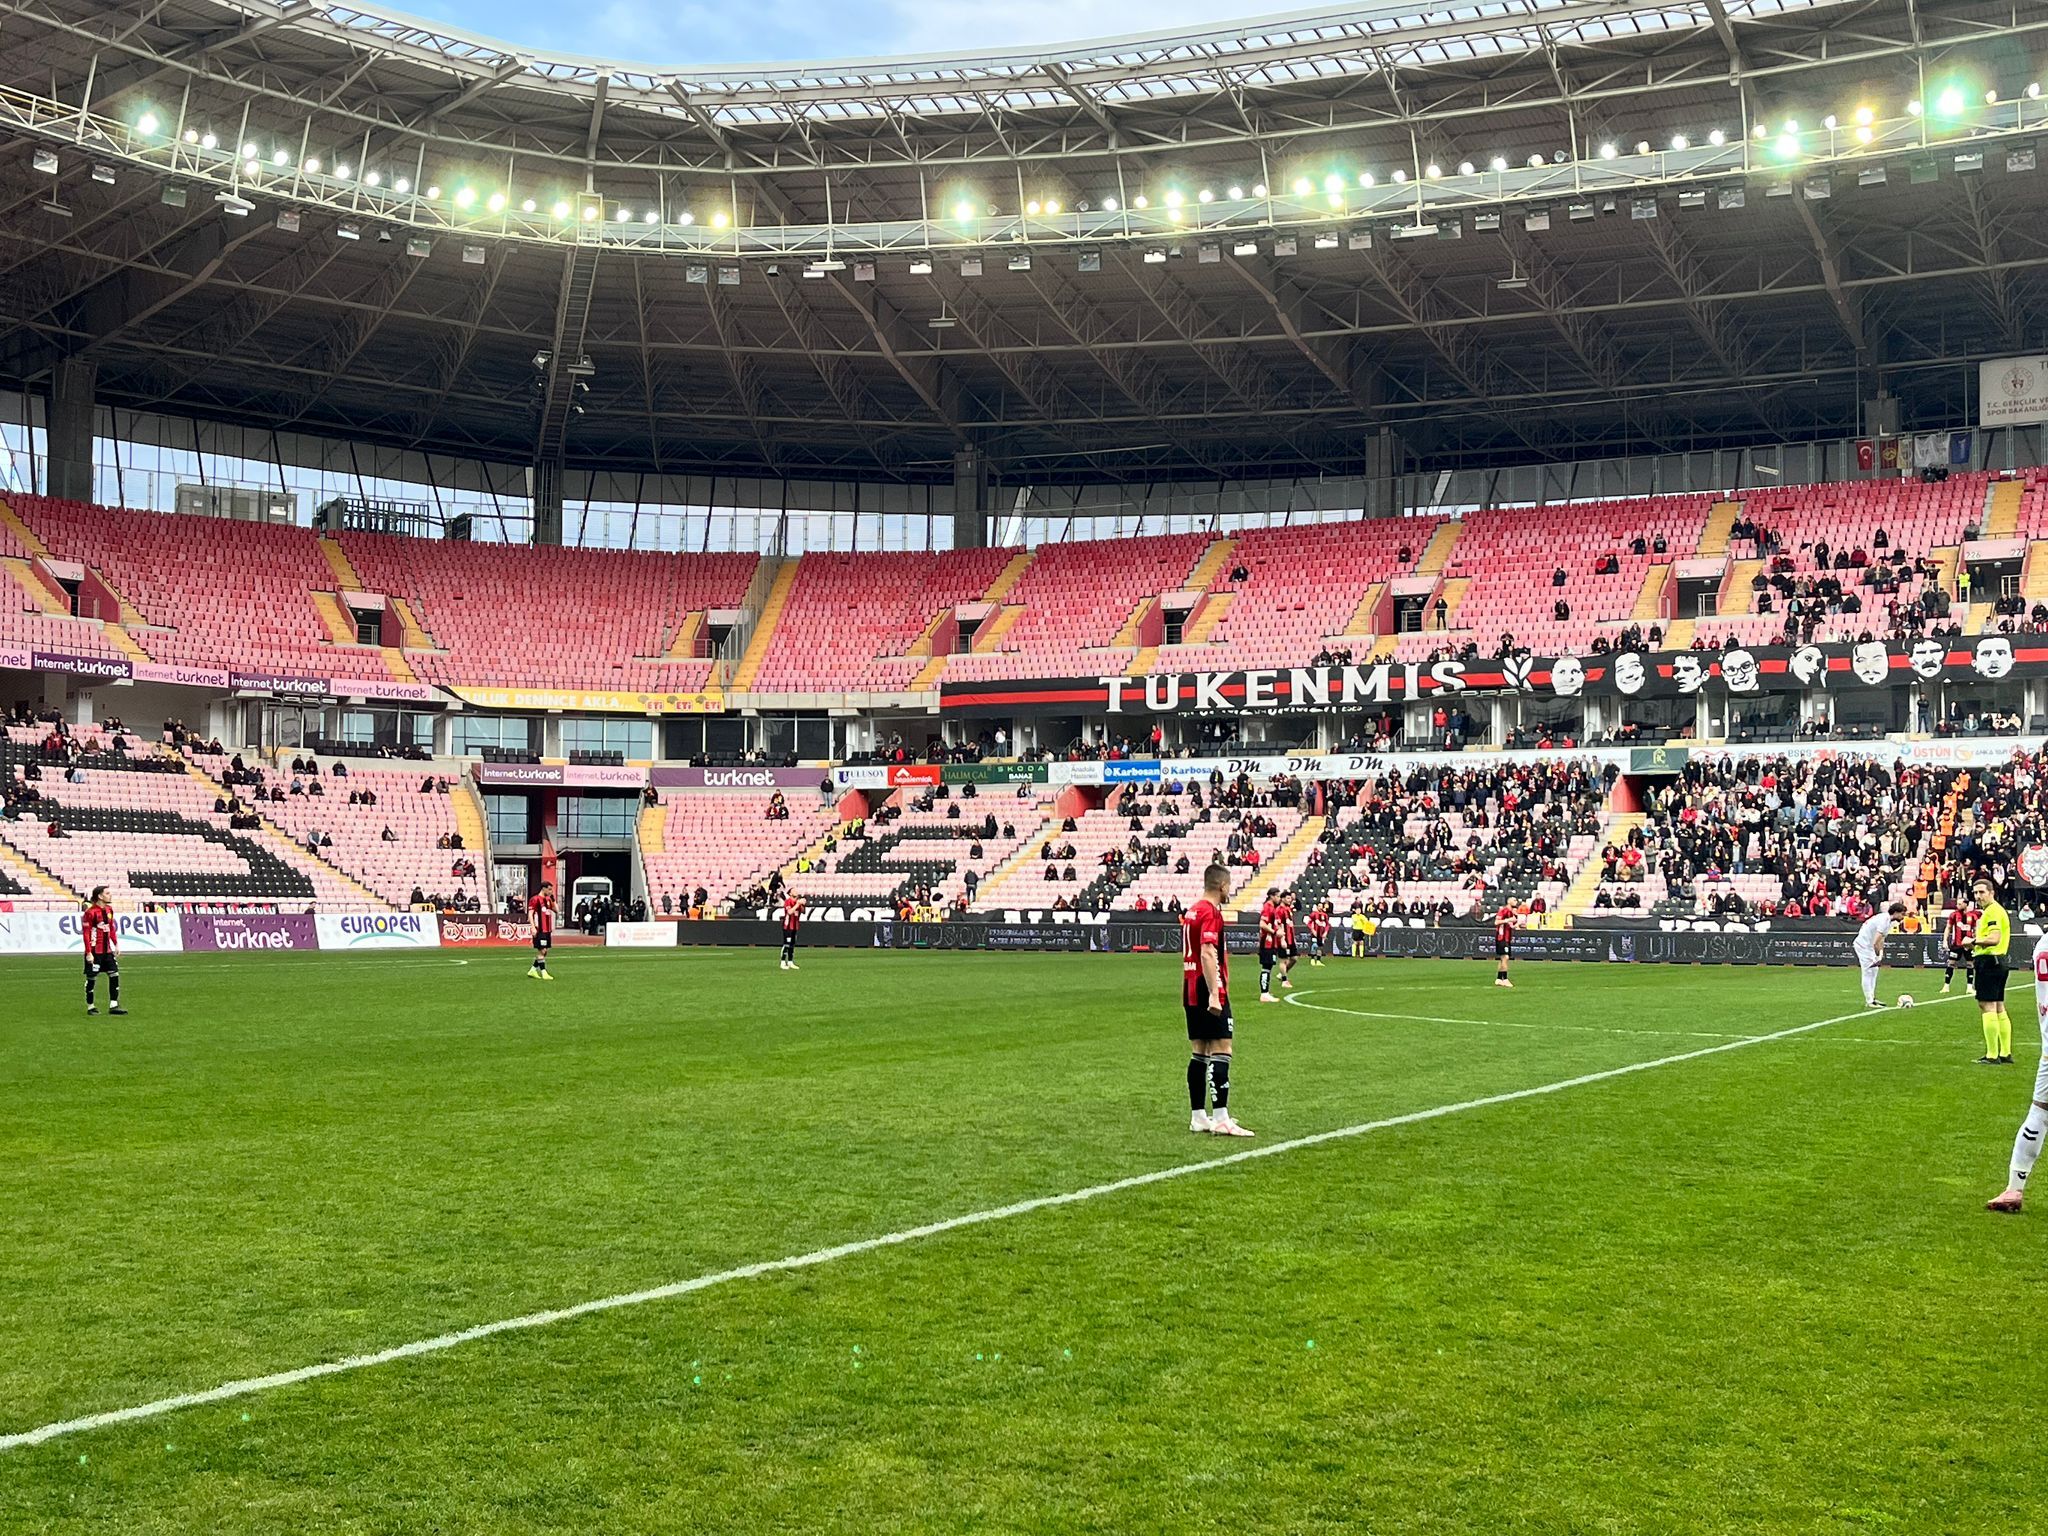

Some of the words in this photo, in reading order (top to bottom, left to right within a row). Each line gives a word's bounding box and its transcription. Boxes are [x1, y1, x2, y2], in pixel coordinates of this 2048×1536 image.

[2003, 398, 2037, 408] GENÇLİK
[2009, 404, 2048, 414] BAKANLIĞ
[0, 654, 27, 666] net
[77, 659, 130, 677] turknet
[176, 670, 225, 686] turknet
[273, 678, 327, 693] turknet
[376, 685, 427, 699] turknet
[515, 692, 576, 707] DENİNCE
[518, 769, 561, 779] turknet
[600, 771, 642, 781] turknet
[704, 769, 775, 785] turknet
[1113, 767, 1160, 777] Karbosan
[59, 915, 157, 935] EUPEN
[341, 915, 421, 933] EUROPEN
[215, 928, 294, 949] turknet
